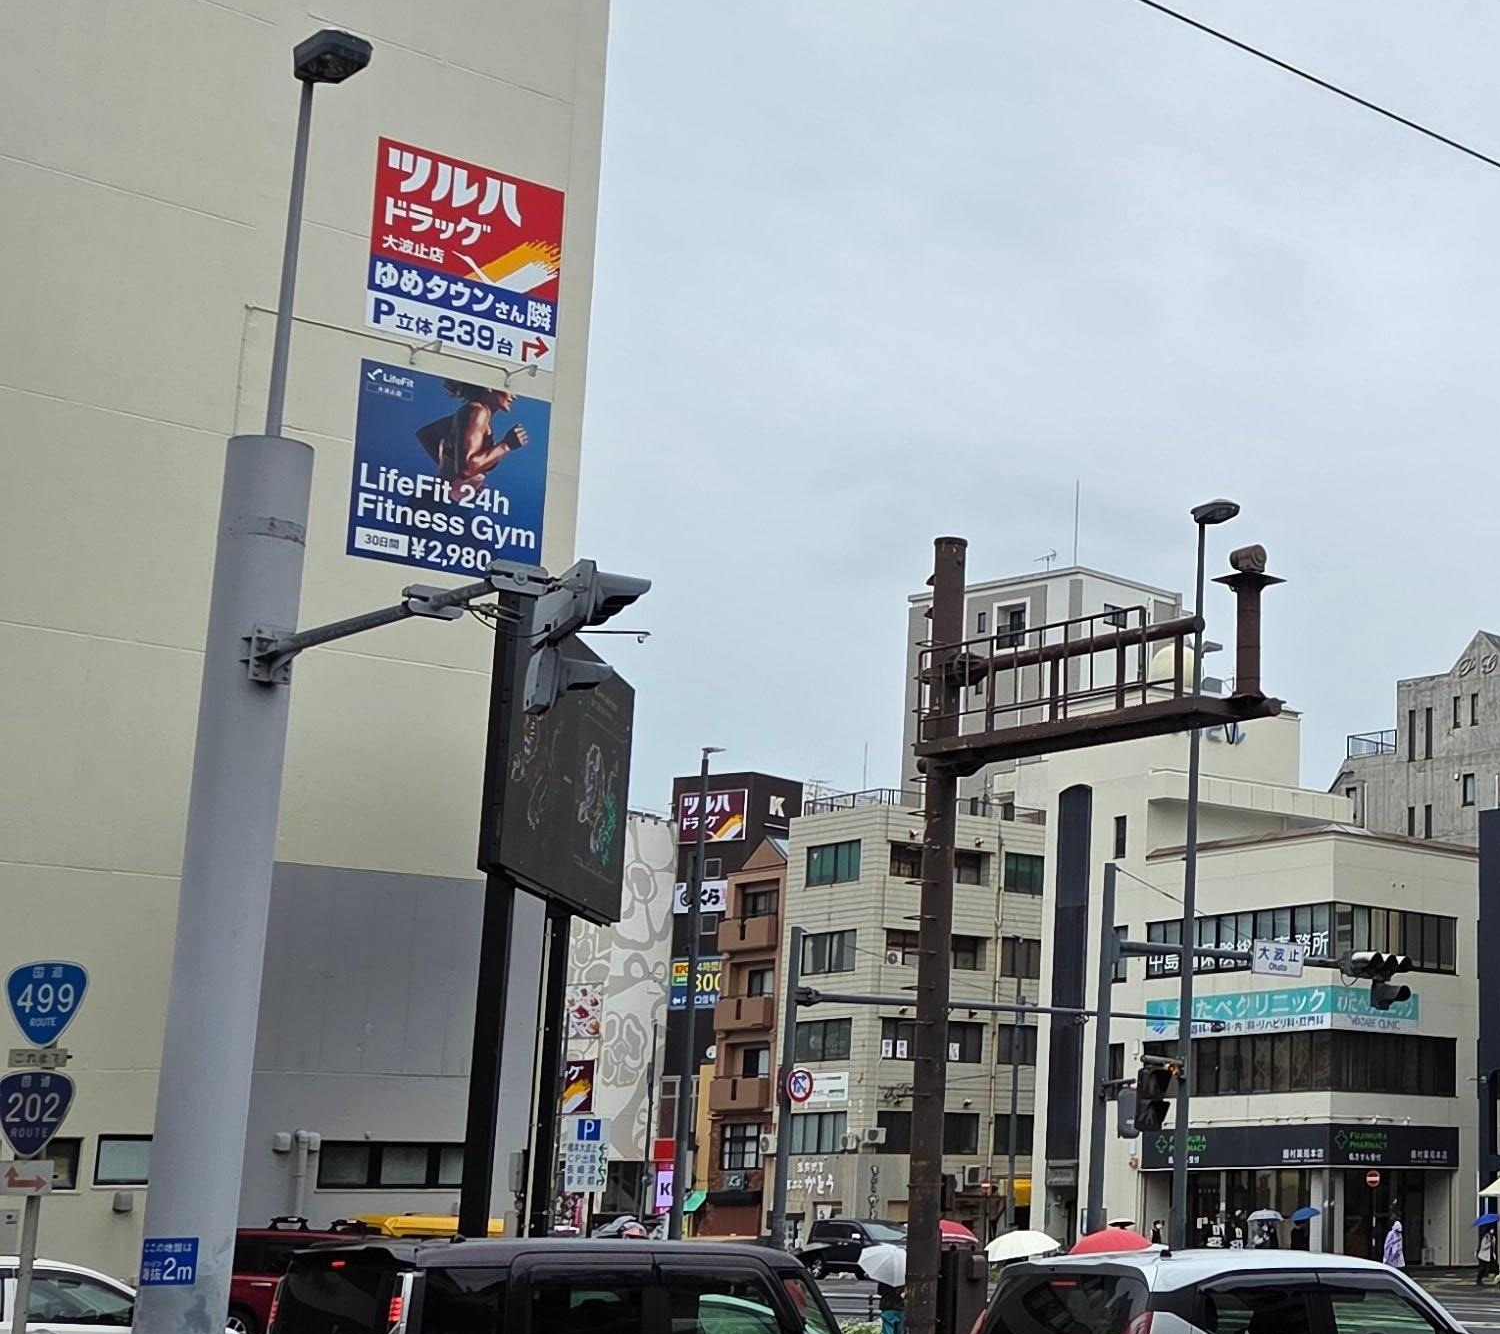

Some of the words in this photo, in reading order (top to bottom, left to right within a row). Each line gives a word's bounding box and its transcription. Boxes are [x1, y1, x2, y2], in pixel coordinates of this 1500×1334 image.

[387, 146, 522, 228] ツルハ
[384, 195, 492, 246] ドラッグ
[382, 234, 446, 264] 大波止店
[374, 259, 553, 332] ゆめタウンさん隣
[382, 372, 415, 388] LifeFit
[359, 462, 452, 504] LifeFit
[458, 484, 510, 515] 24h
[356, 492, 465, 536] Fitness
[471, 515, 536, 549] Gym
[363, 532, 400, 549] 30日間
[411, 536, 491, 572] ¥2,980
[682, 815, 720, 831] ドラグ
[1258, 946, 1301, 963] 大波止
[17, 983, 75, 1013] 499
[29, 1017, 57, 1027] ROUTE
[5, 1092, 60, 1123] 202
[10, 1127, 49, 1138] ROUTE
[584, 1120, 595, 1140] P
